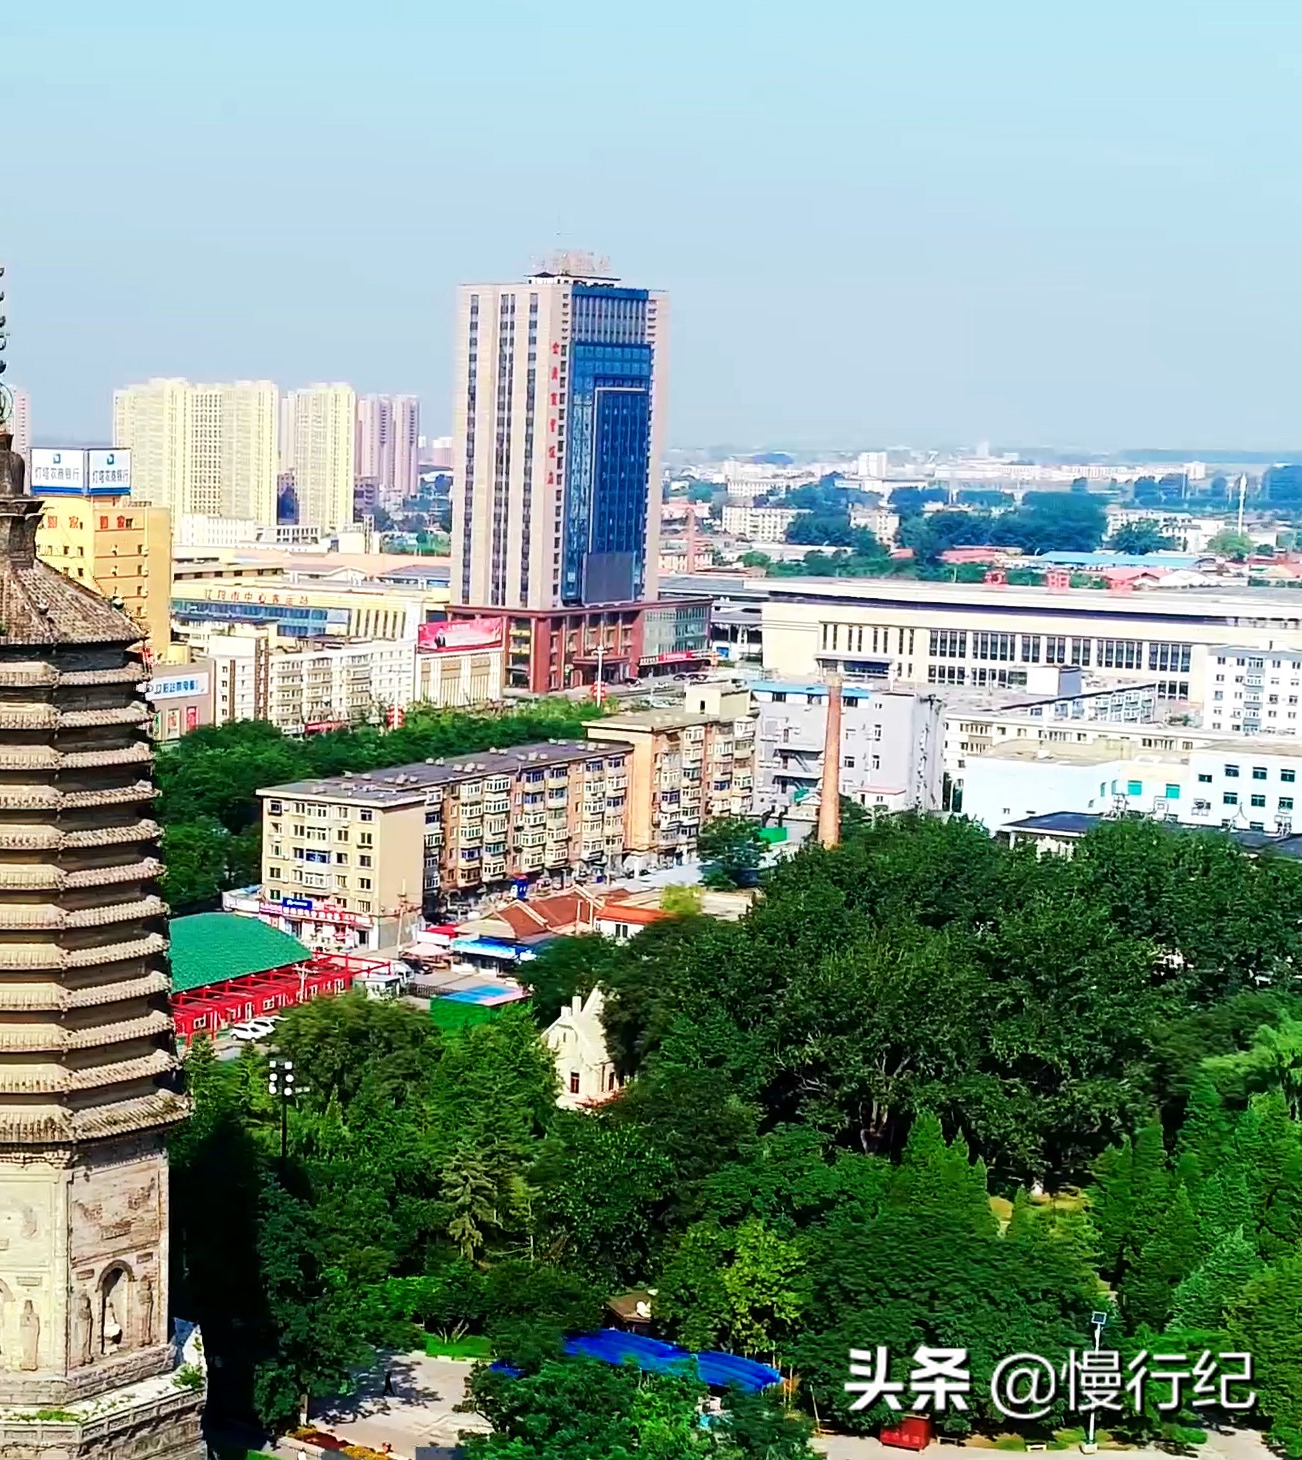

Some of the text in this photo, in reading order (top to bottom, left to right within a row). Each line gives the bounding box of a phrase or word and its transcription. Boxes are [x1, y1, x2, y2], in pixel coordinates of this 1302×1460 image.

[35, 466, 80, 480] 灯塔农商银行
